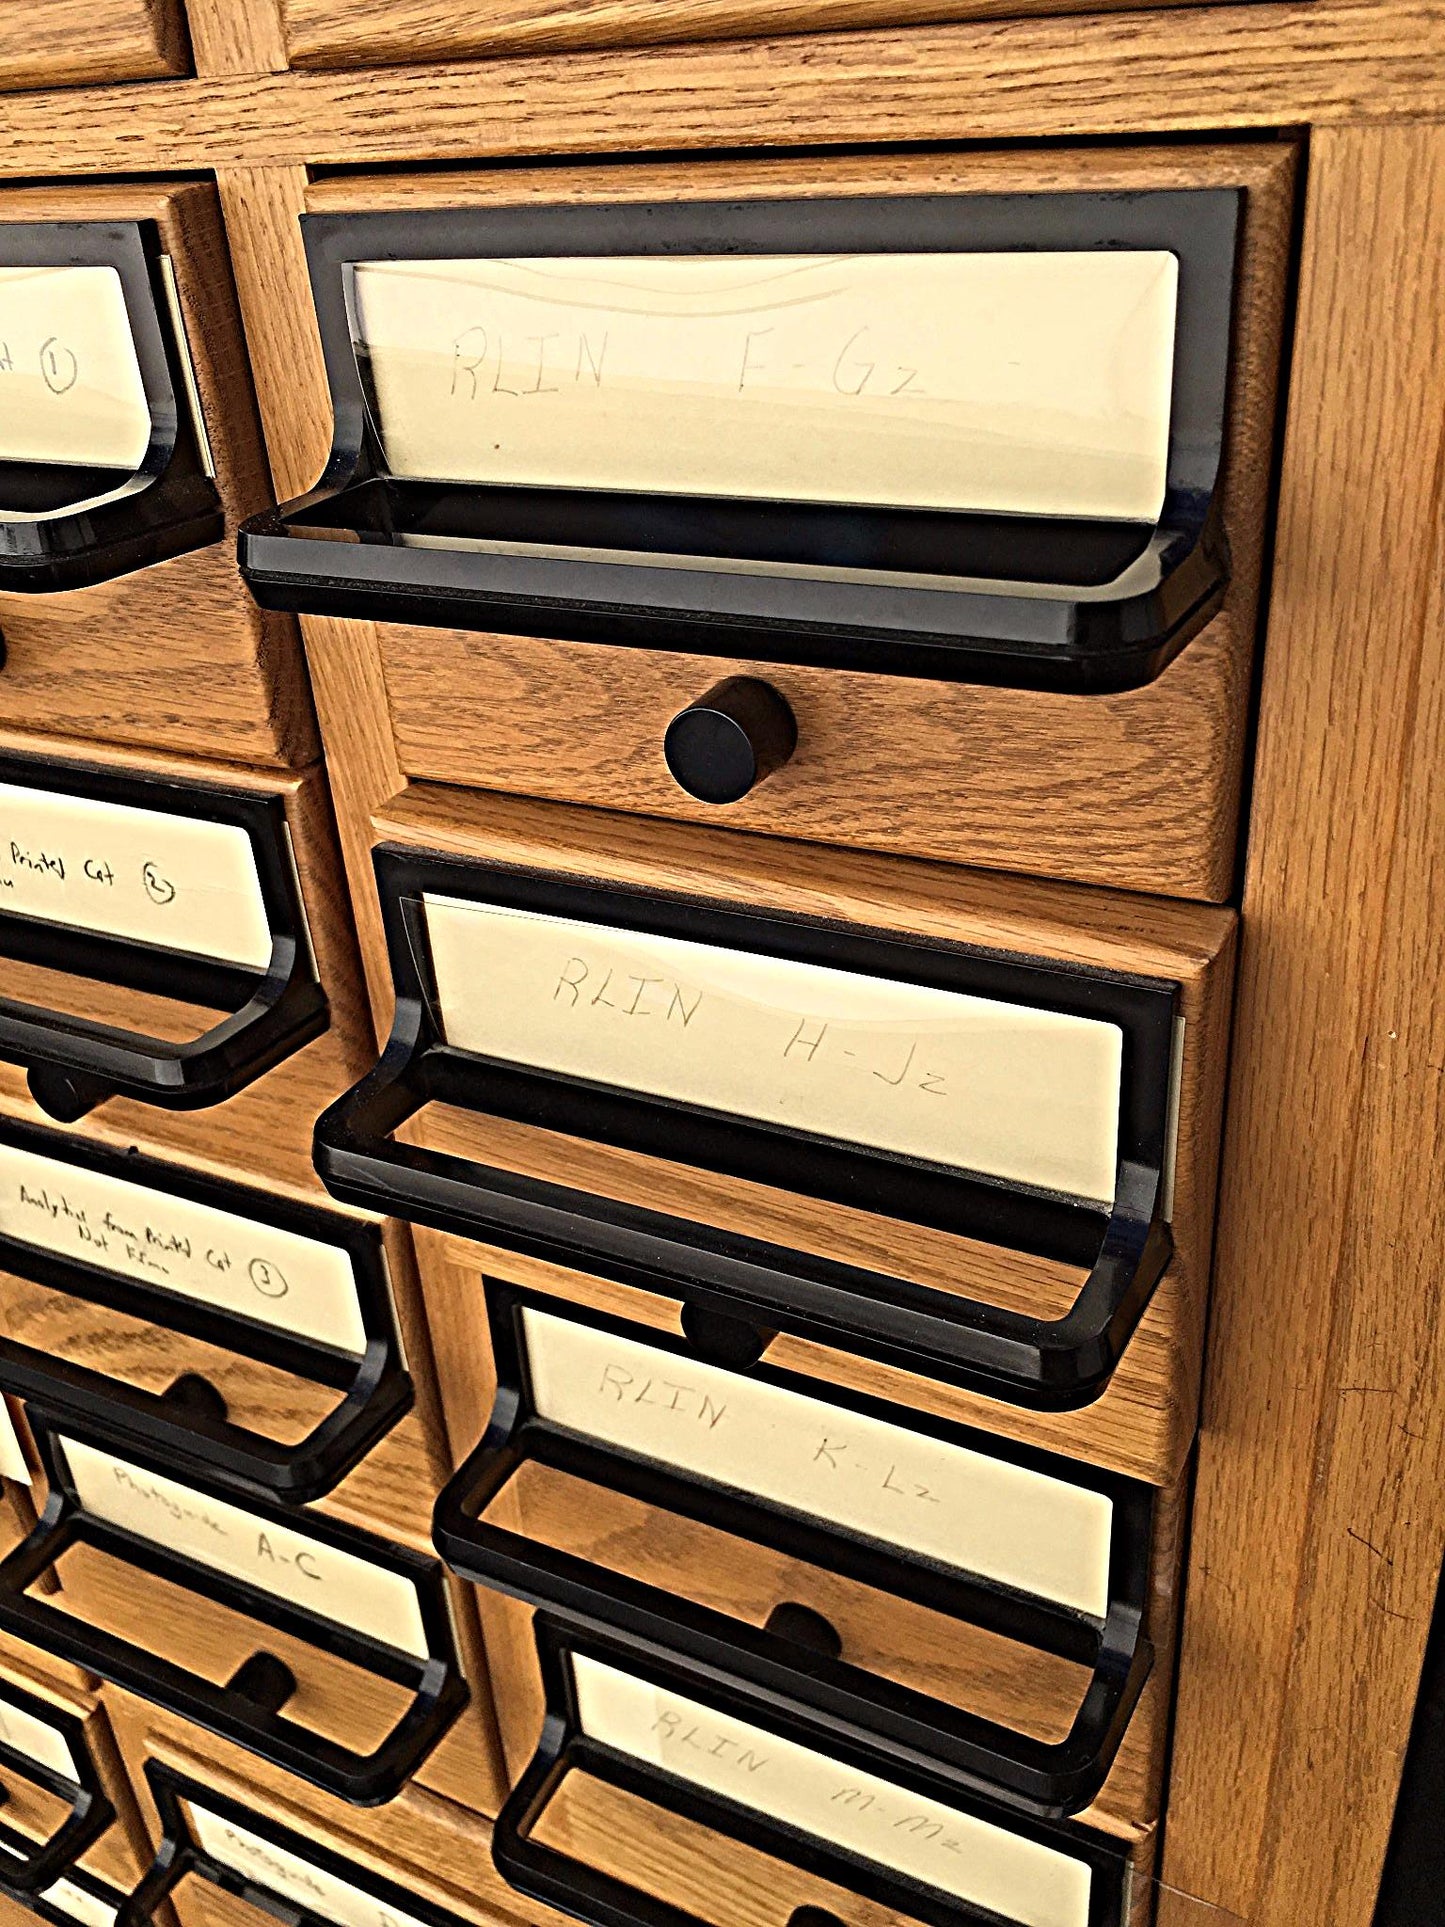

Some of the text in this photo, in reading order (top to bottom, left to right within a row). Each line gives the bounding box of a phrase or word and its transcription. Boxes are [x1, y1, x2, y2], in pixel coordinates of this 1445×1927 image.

[450, 326, 608, 400] RLIN
[10, 841, 66, 881] Printed
[84, 859, 115, 887] Cat
[552, 957, 703, 1028] RLIN
[599, 1363, 729, 1429] RLIN
[651, 1708, 771, 1774] RLIN
